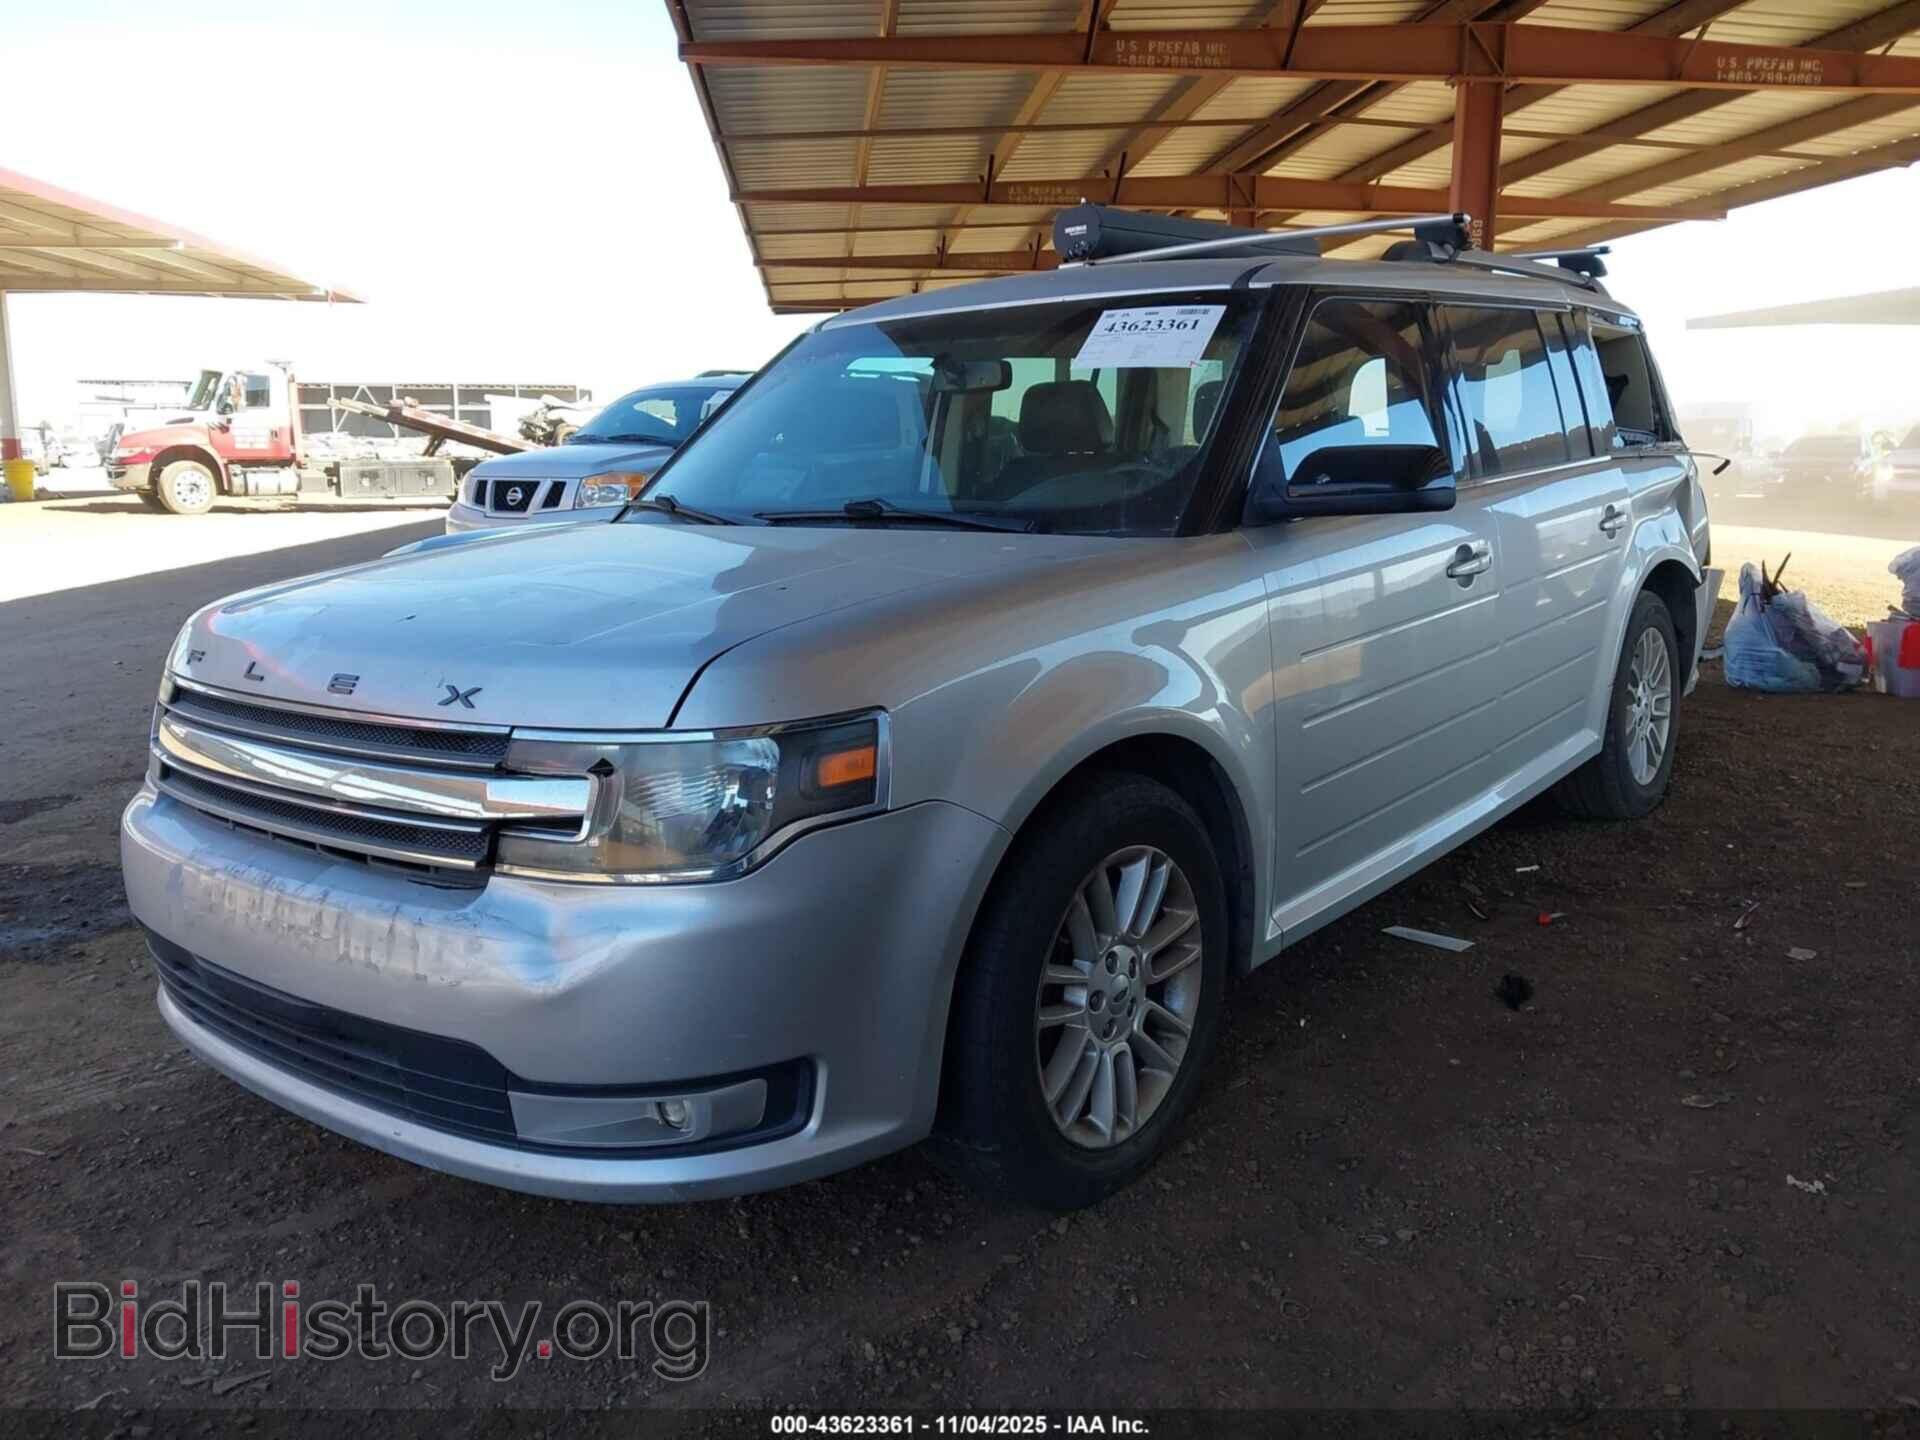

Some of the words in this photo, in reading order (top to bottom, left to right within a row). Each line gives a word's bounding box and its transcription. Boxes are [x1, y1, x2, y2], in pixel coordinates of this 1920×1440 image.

[1147, 40, 1201, 55] PREFAB
[1745, 57, 1796, 72] PREFAB
[1103, 318, 1201, 334] 43623361
